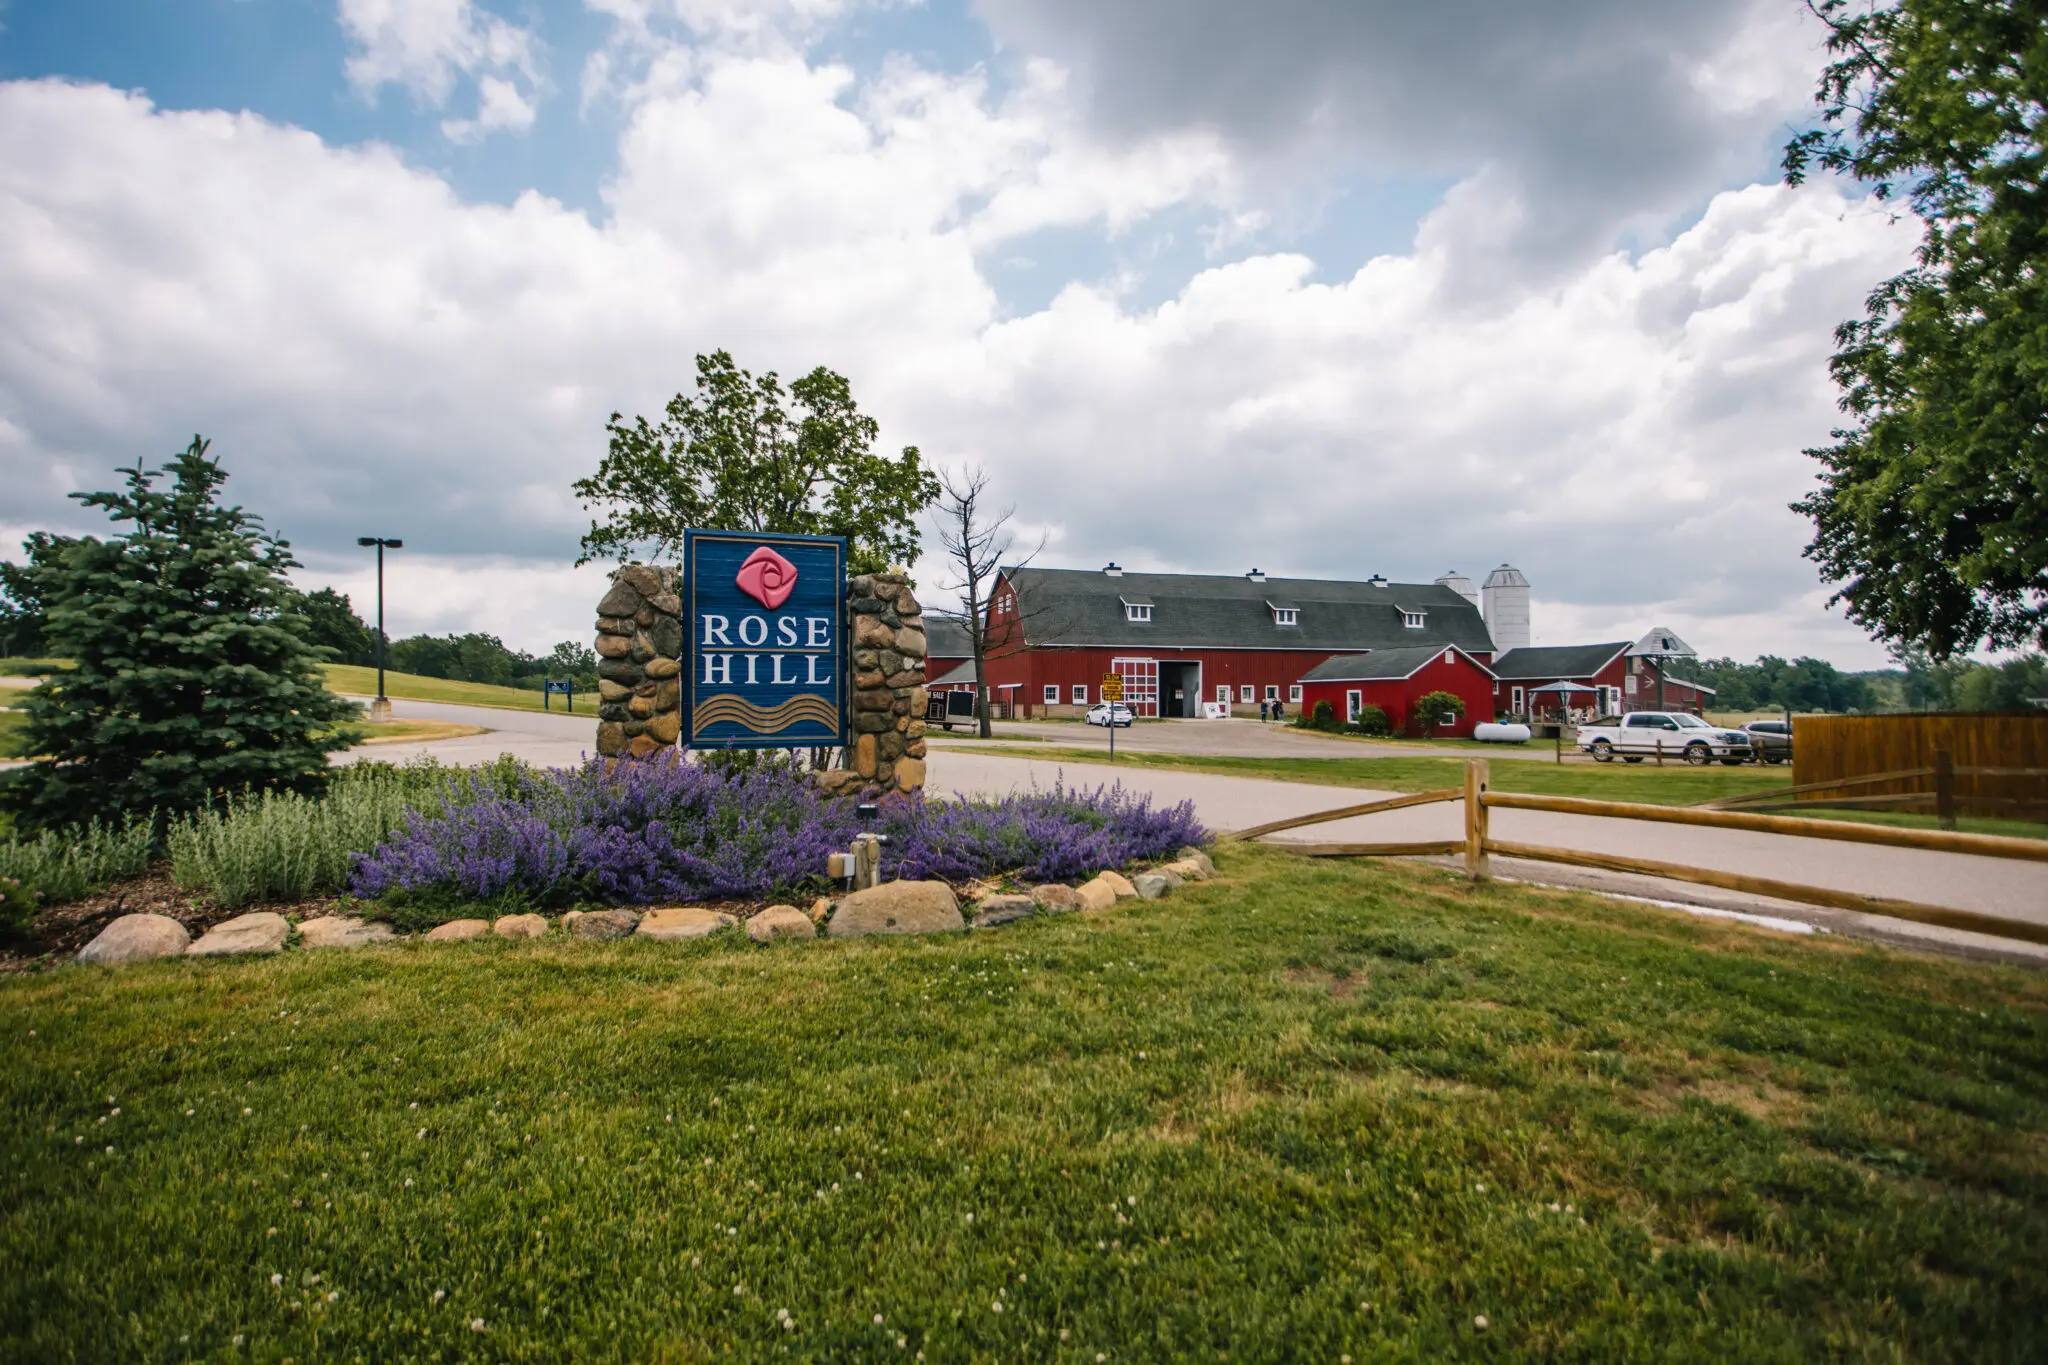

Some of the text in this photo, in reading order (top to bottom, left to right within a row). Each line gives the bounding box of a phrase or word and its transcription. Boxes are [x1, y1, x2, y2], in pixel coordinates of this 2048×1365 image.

[701, 614, 831, 647] ROSE
[701, 653, 831, 685] HILL
[932, 691, 945, 699] SALE
